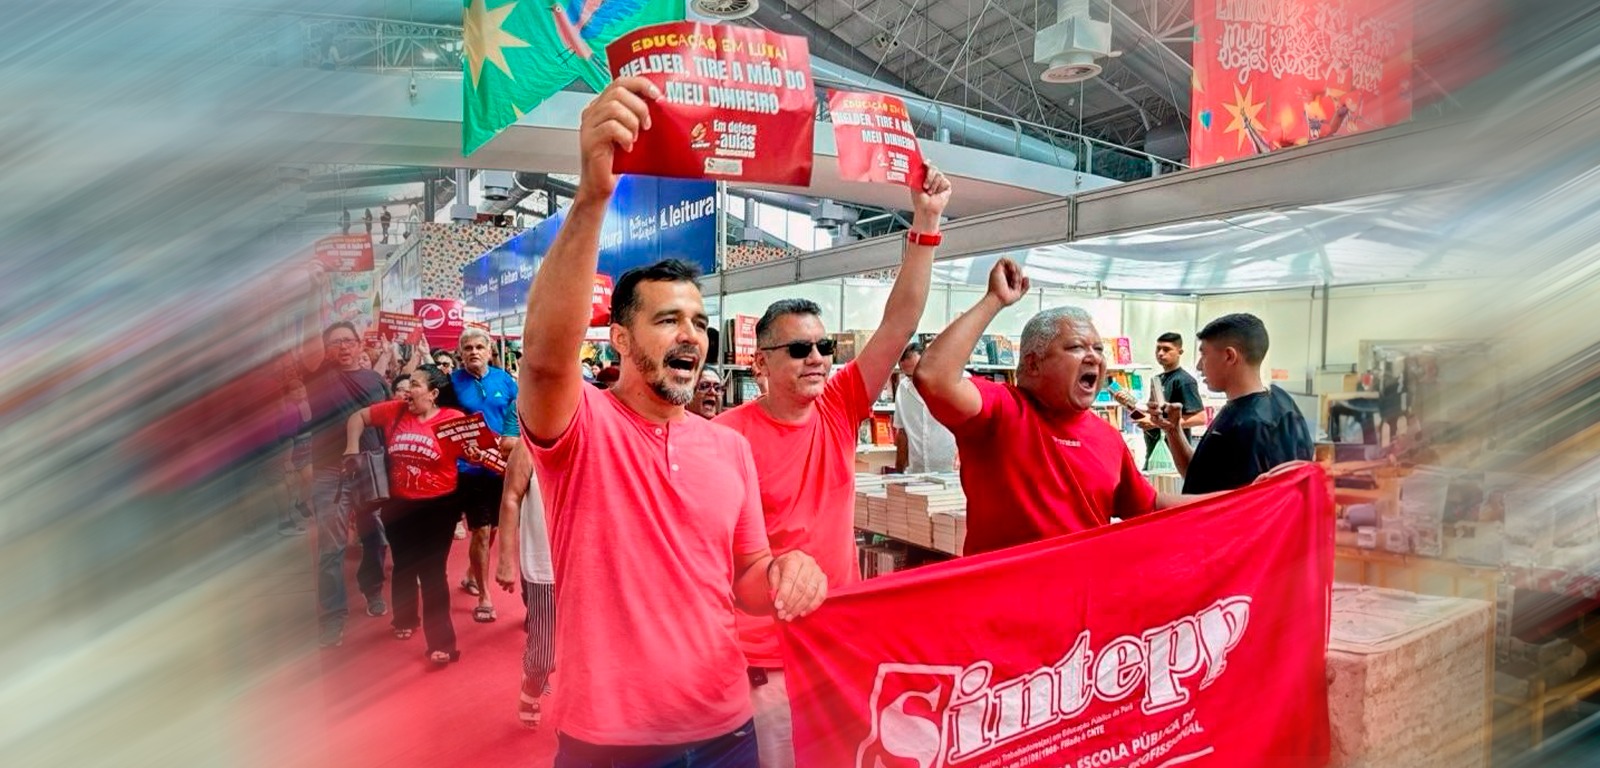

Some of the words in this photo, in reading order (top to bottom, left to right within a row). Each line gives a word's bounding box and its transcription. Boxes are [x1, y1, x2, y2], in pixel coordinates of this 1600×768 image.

[631, 33, 717, 53] EDUCAÇÃO
[721, 39, 744, 53] EM
[619, 53, 690, 78] HELDER,
[693, 56, 728, 80] TIRE
[732, 62, 744, 82] A
[747, 61, 782, 88] MÃO
[786, 69, 806, 90] DO
[665, 81, 703, 106] MEU
[708, 86, 779, 115] DINHEIRO
[713, 119, 727, 132] Em
[728, 120, 757, 135] defesa
[875, 114, 894, 129] TIRE
[720, 132, 756, 150] aulas
[861, 130, 882, 144] MEU
[669, 196, 715, 228] leitura
[880, 595, 1252, 768] Sintepp
[1086, 724, 1105, 737] CNTE
[1076, 743, 1130, 768] ESCOLA
